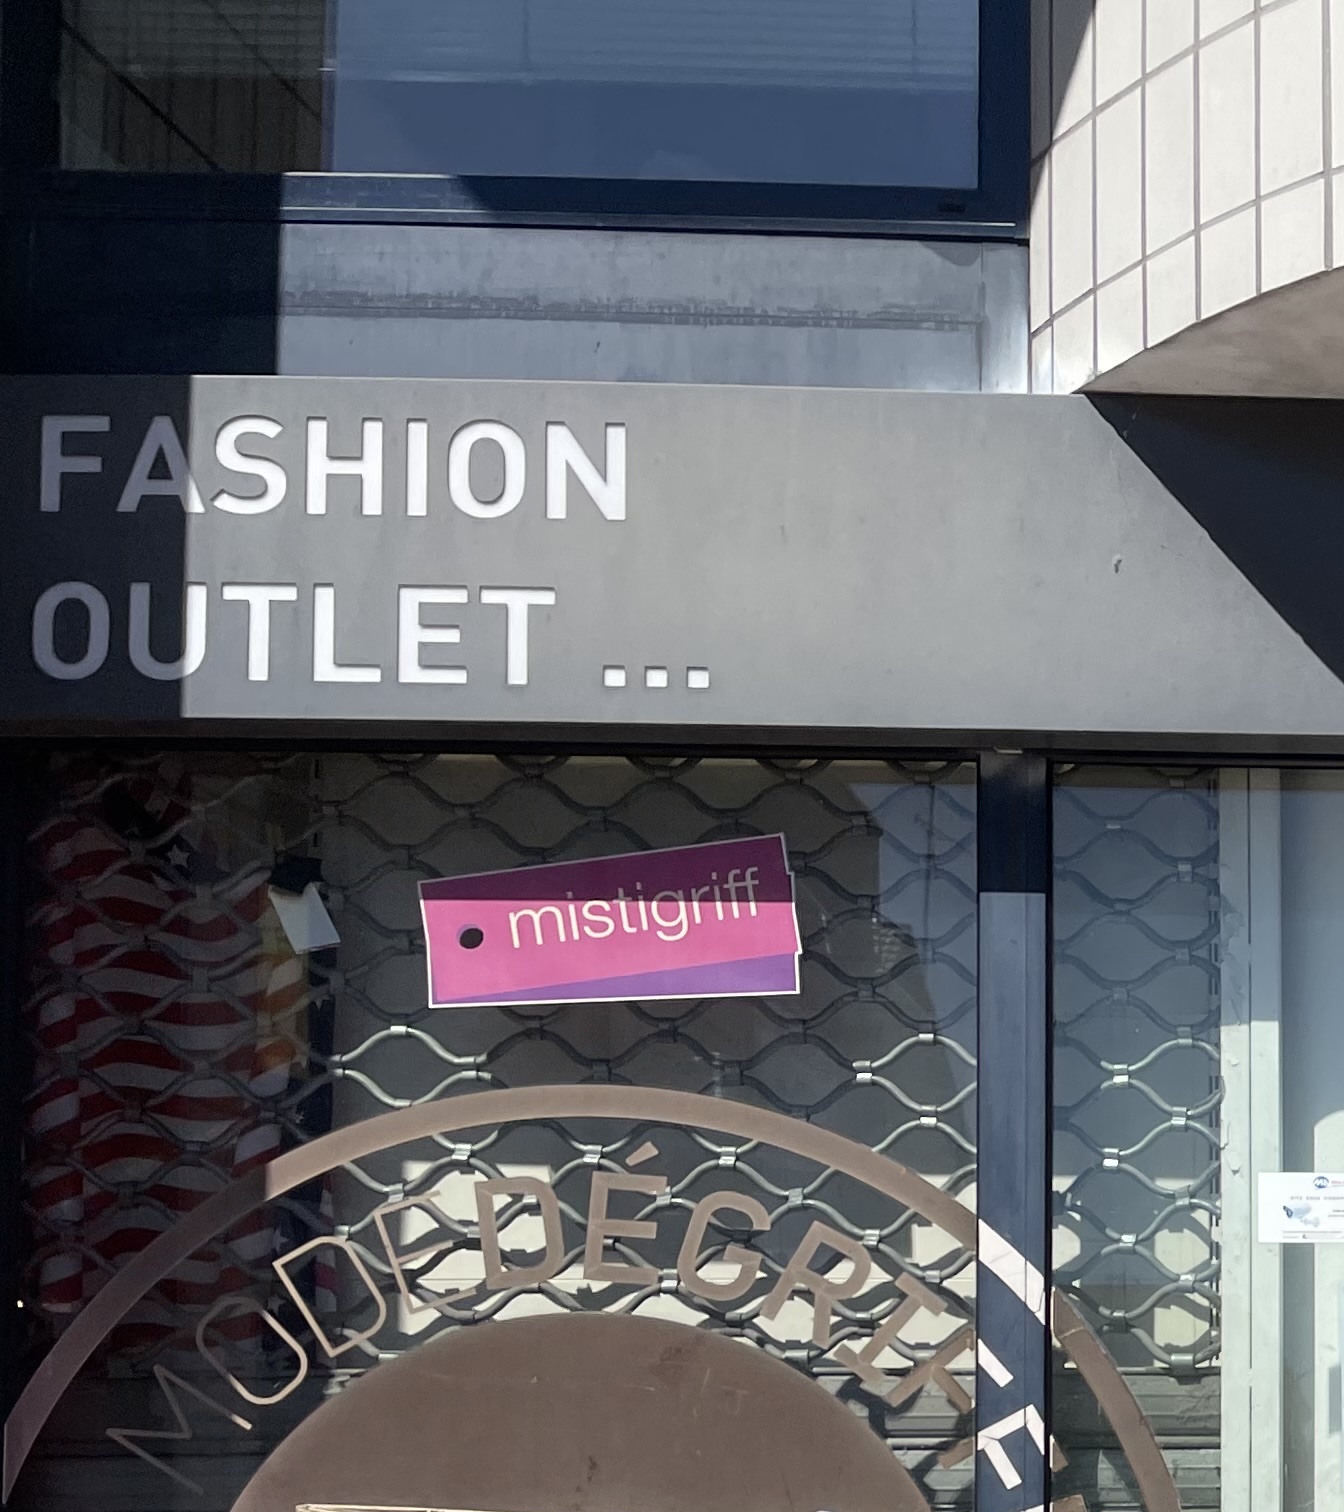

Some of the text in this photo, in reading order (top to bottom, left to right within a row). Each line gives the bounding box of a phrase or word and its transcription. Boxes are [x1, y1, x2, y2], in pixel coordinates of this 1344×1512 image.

[39, 414, 628, 522] FASHION
[30, 580, 556, 685] OUTLET
[507, 866, 761, 952] mistigriff
[105, 1191, 477, 1493] MODE
